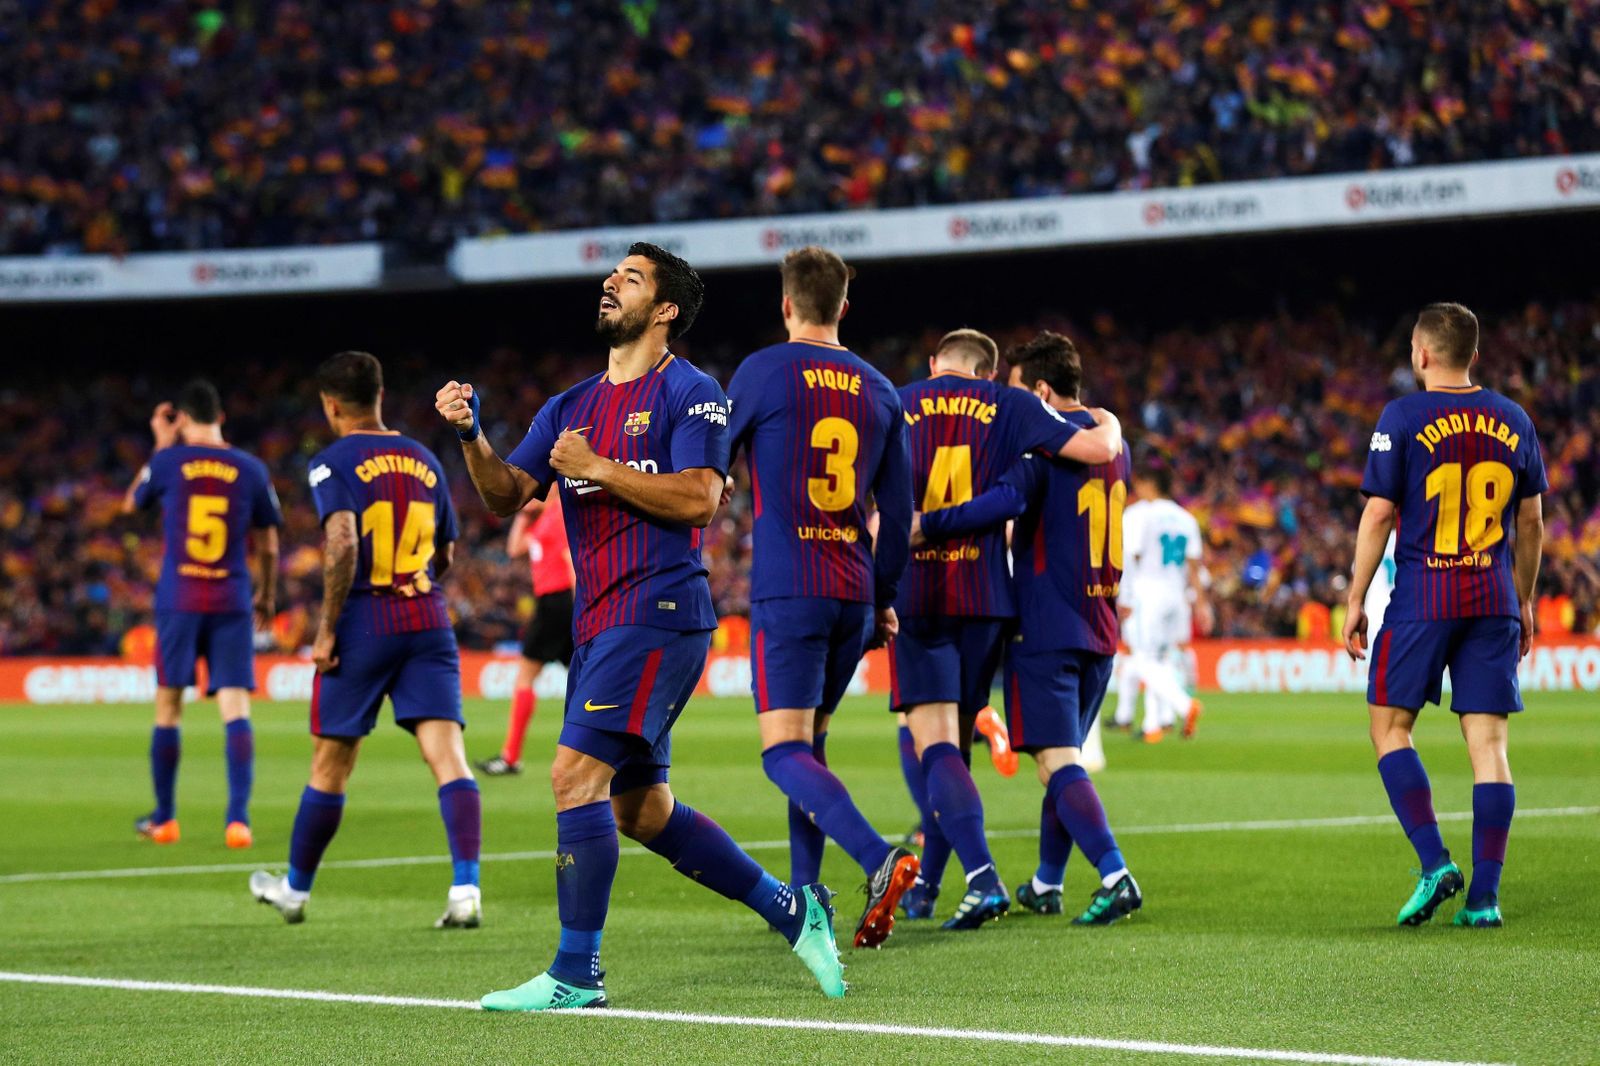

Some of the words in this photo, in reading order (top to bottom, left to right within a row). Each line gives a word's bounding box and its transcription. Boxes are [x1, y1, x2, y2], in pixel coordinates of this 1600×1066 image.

[803, 369, 861, 396] PIQUÉ
[808, 417, 858, 511] 3
[1416, 413, 1470, 453] JORDI
[1475, 415, 1520, 452] ALBA
[355, 455, 437, 488] COUTINHO
[922, 445, 973, 514] 4
[186, 495, 229, 563] 5
[1078, 478, 1127, 571] 10
[1425, 461, 1514, 555] 18
[362, 501, 435, 586] 14
